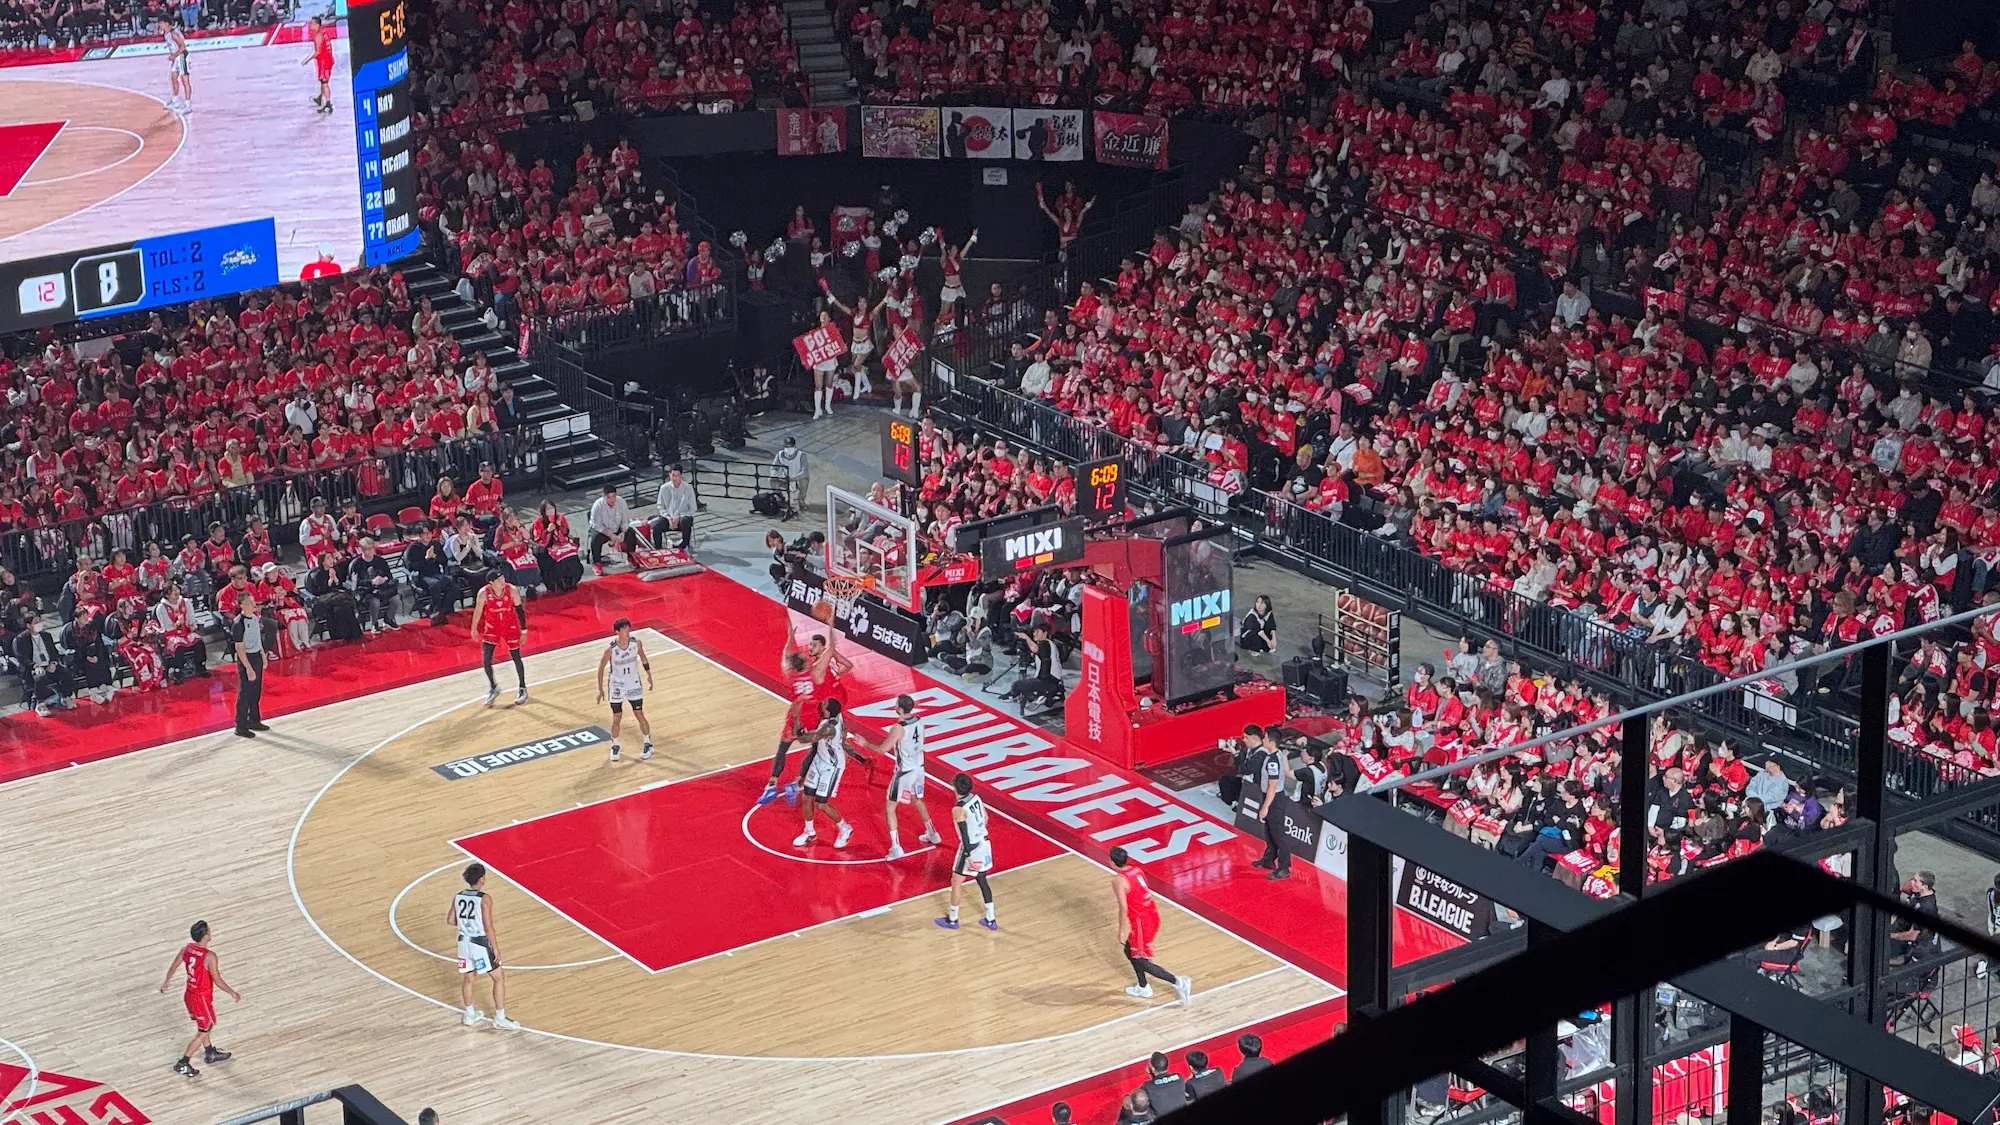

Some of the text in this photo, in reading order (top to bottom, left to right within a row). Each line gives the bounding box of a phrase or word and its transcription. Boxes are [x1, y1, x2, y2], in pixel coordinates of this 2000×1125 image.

[363, 98, 371, 116] 4
[364, 130, 375, 148] 11
[365, 160, 379, 179] 14
[366, 190, 382, 211] 22
[367, 221, 384, 241] 77
[37, 281, 55, 302] 12
[890, 420, 912, 445] 6:09
[894, 443, 911, 471] 12
[1090, 463, 1119, 487] 6:09
[1095, 482, 1116, 510] 12
[1005, 527, 1063, 562] MIXI
[944, 567, 965, 578] MIXI
[1171, 588, 1231, 627] MIXI
[872, 623, 913, 654] ちばぎん
[622, 667, 631, 675] 11
[1087, 662, 1102, 744] 日本電技
[912, 725, 920, 744] 4
[480, 730, 600, 767] B.LEAGUE
[1284, 815, 1314, 846] Bank
[458, 899, 475, 920] 22
[1408, 884, 1475, 934] B.LEAGUE
[188, 956, 197, 976] 2
